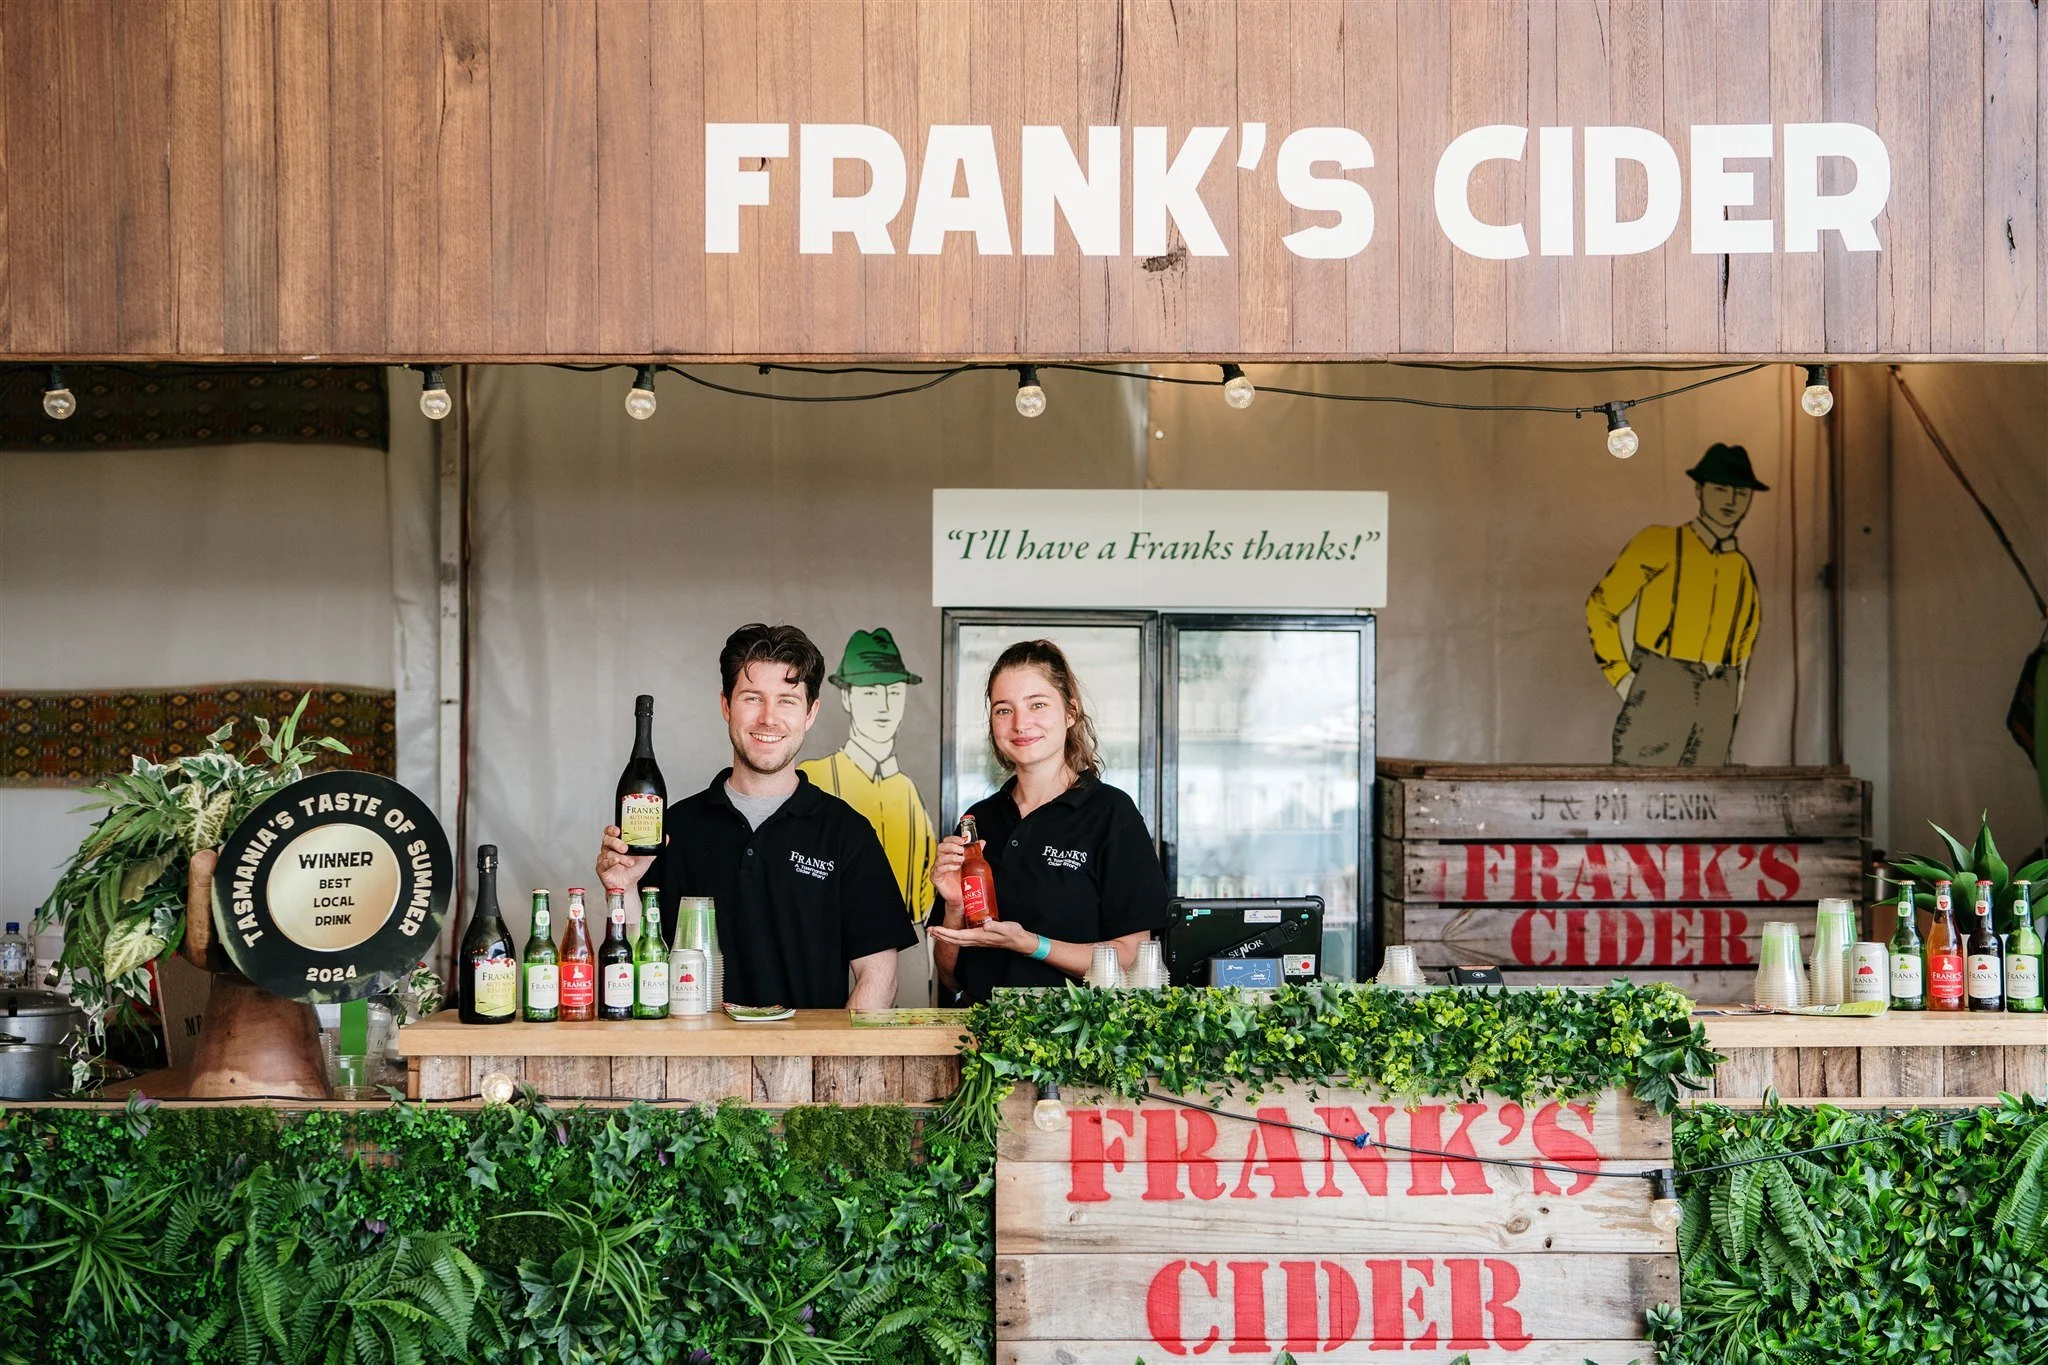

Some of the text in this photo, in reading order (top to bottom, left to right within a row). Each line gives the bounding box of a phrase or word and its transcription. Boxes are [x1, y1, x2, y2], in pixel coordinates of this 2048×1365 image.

[705, 122, 1891, 259] FRANK'S CIDER
[1016, 528, 1089, 561] have
[1097, 541, 1117, 560] a
[1125, 529, 1233, 561] Franks
[626, 805, 660, 814] FRANK'S
[1531, 794, 1545, 820] J
[299, 850, 374, 870] WINNER
[788, 850, 835, 872] FRANK'S
[1042, 845, 1088, 863] FRANK'S
[232, 792, 433, 948] TASMANIA'S TASTE OF SUMMER
[1462, 844, 1801, 902] FRANK'S
[319, 877, 352, 889] BEST
[313, 896, 355, 908] LOCAL
[315, 914, 352, 926] DRINK
[1511, 908, 1754, 967] CIDER
[305, 964, 357, 983] 2024
[1931, 971, 1962, 980] FRANK'S
[2007, 971, 2038, 980] FRANK'S
[563, 980, 592, 988] FRANK'S
[1066, 1100, 1602, 1202] FRANK'S
[1146, 1257, 1534, 1356] CIDER
